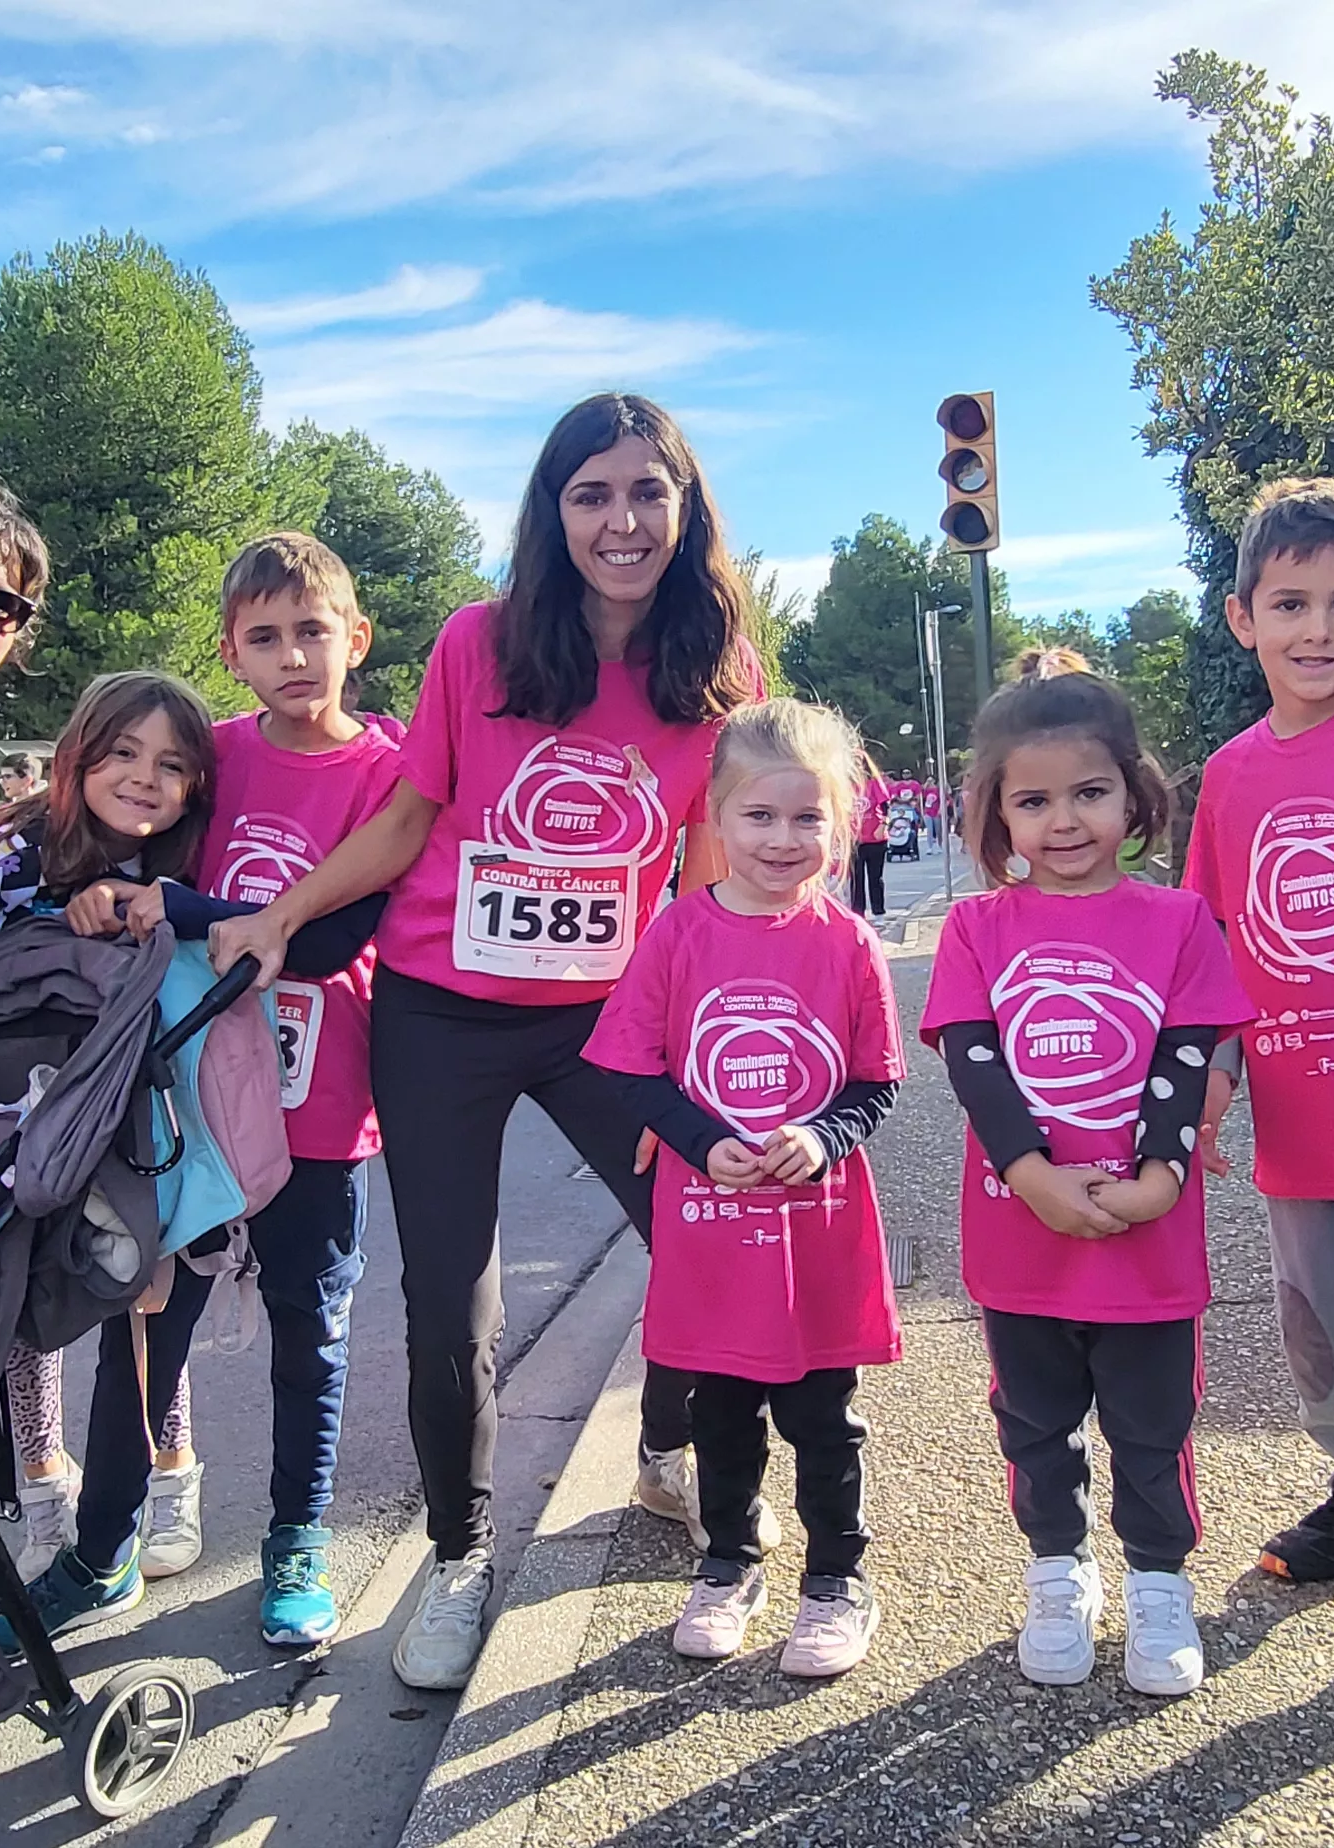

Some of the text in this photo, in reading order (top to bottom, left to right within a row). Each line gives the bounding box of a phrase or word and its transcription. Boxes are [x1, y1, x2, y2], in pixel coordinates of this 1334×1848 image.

[545, 813, 597, 830] JUNTOS
[481, 868, 620, 891] CONTRA EL CÁNCER
[528, 866, 571, 878] HUESCA
[478, 891, 617, 944] 1585
[1029, 1034, 1093, 1058] JUNTOS
[722, 1053, 789, 1071] Caminemos
[728, 1068, 786, 1090] JUNTOS
